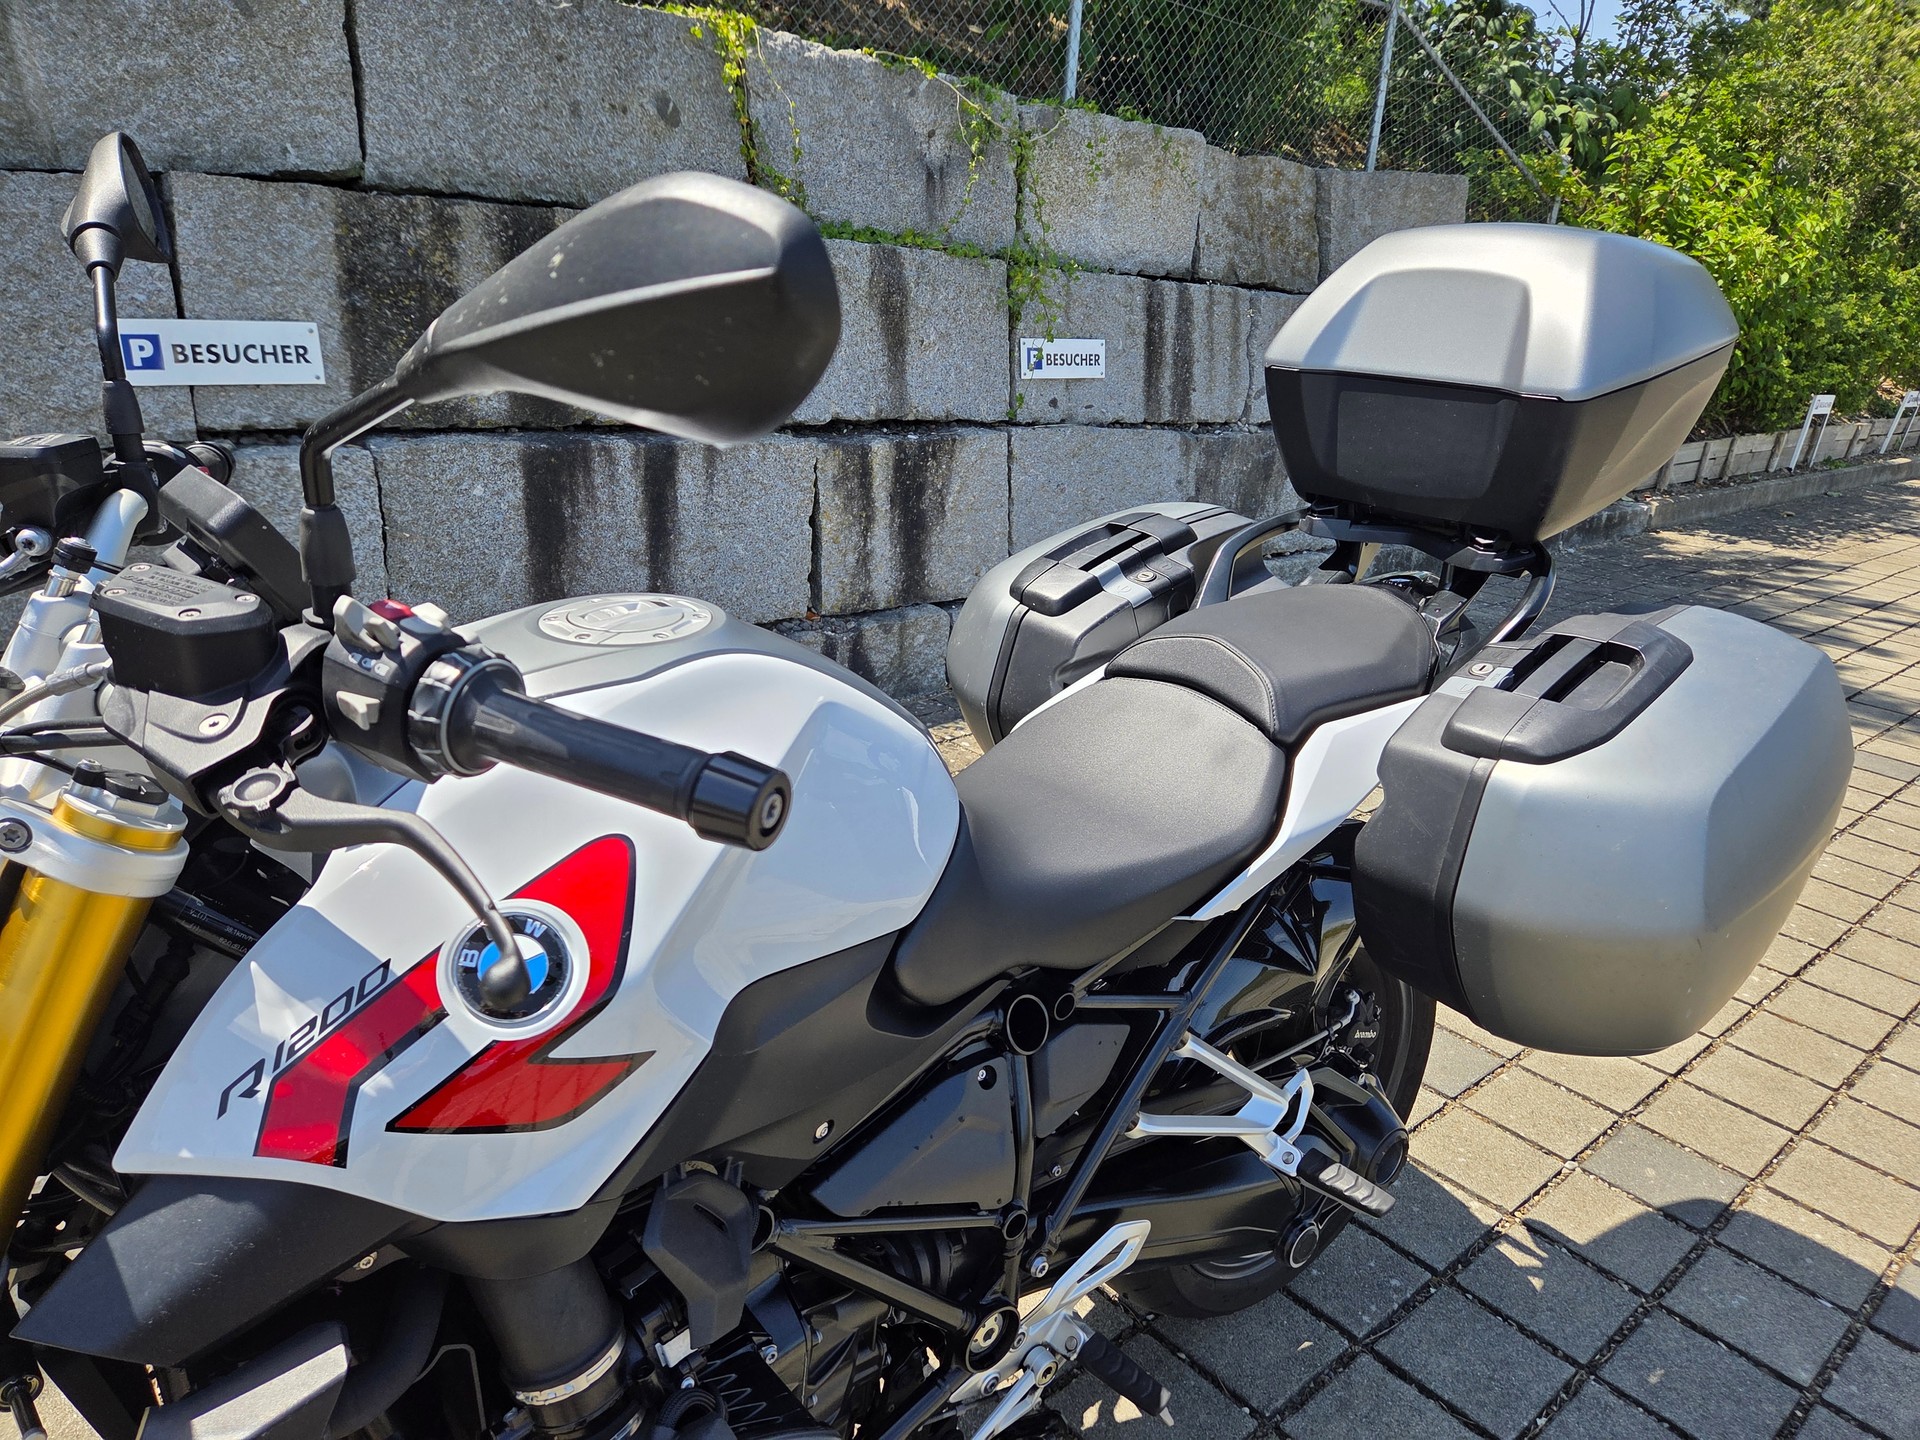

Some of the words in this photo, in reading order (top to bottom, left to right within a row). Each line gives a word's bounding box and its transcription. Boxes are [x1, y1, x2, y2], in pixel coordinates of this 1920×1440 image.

[128, 338, 154, 367] P
[171, 343, 312, 365] BESUCHER
[1046, 353, 1101, 366] BESUCHER
